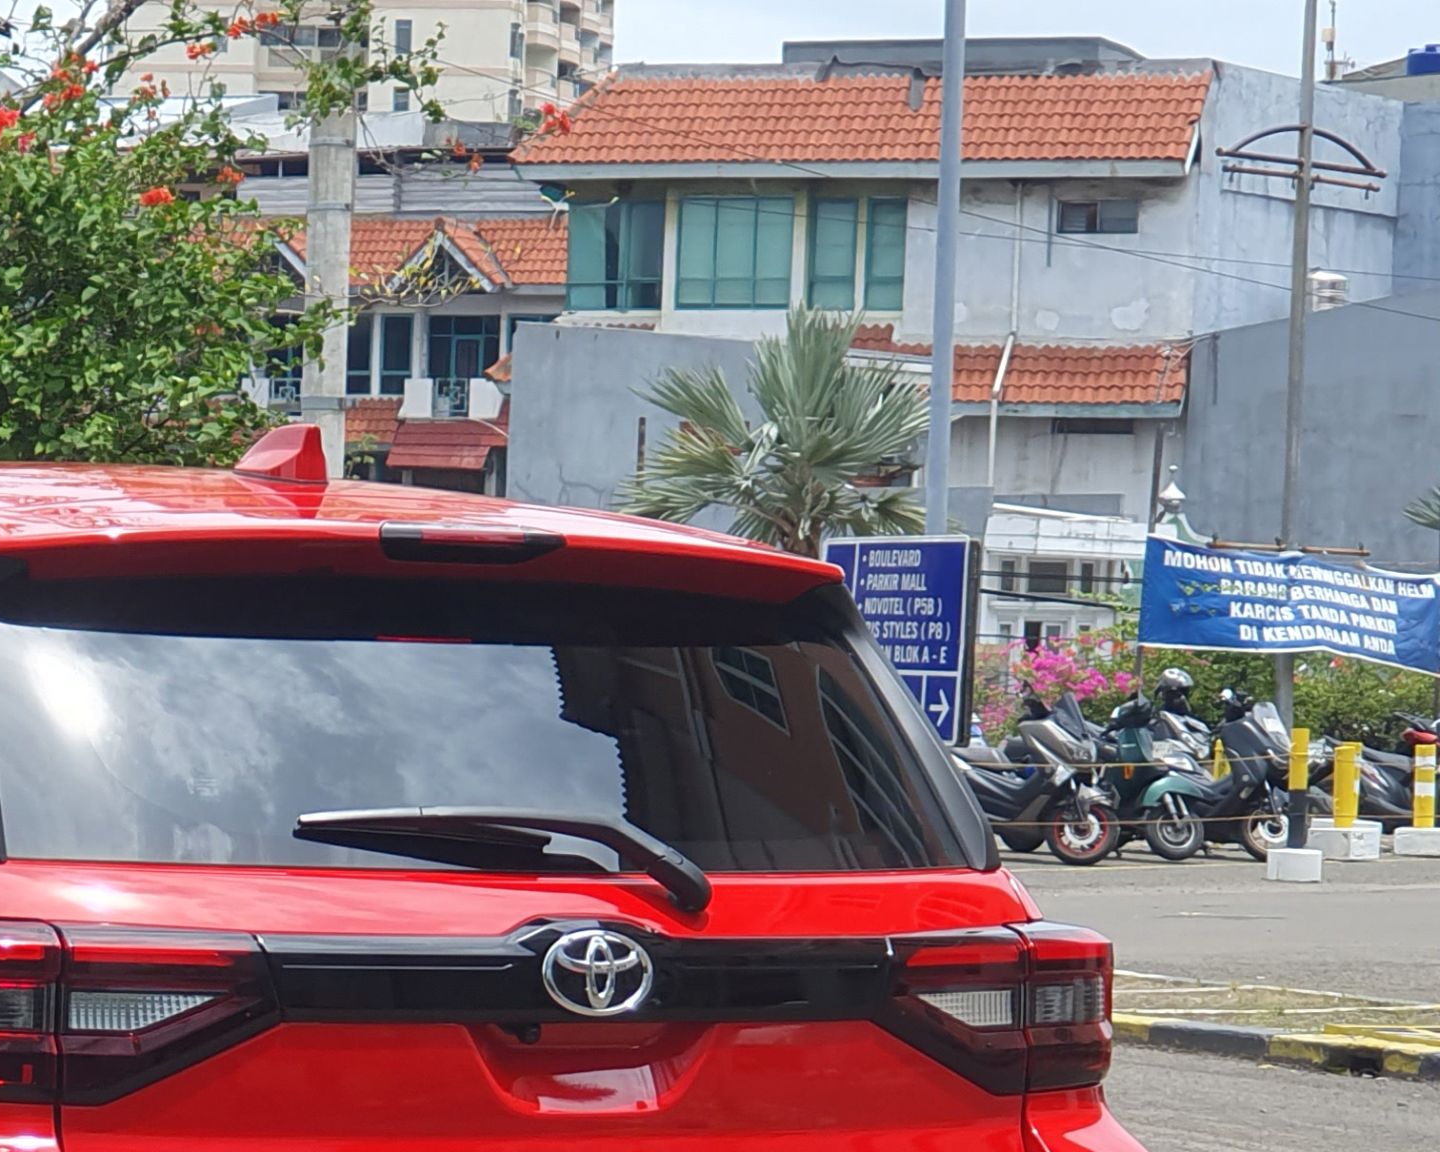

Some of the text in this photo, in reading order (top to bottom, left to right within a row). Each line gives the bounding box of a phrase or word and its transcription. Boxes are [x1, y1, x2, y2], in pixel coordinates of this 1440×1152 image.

[869, 550, 921, 567] BOULEVARD
[865, 573, 927, 591] PARKIR MALL
[1163, 549, 1233, 573] MOHON
[1234, 559, 1288, 580] TIDAK
[1397, 581, 1436, 599] HELM
[863, 597, 905, 615] NOVOTEL
[1289, 584, 1370, 610] BERHARGA
[1370, 595, 1399, 615] DAN
[1229, 601, 1398, 635] KARCIS TANDA PARKIR
[882, 621, 918, 640] STYLES
[1239, 624, 1396, 655] DI KENDARAAN ANDA
[893, 645, 920, 664] BLOK
